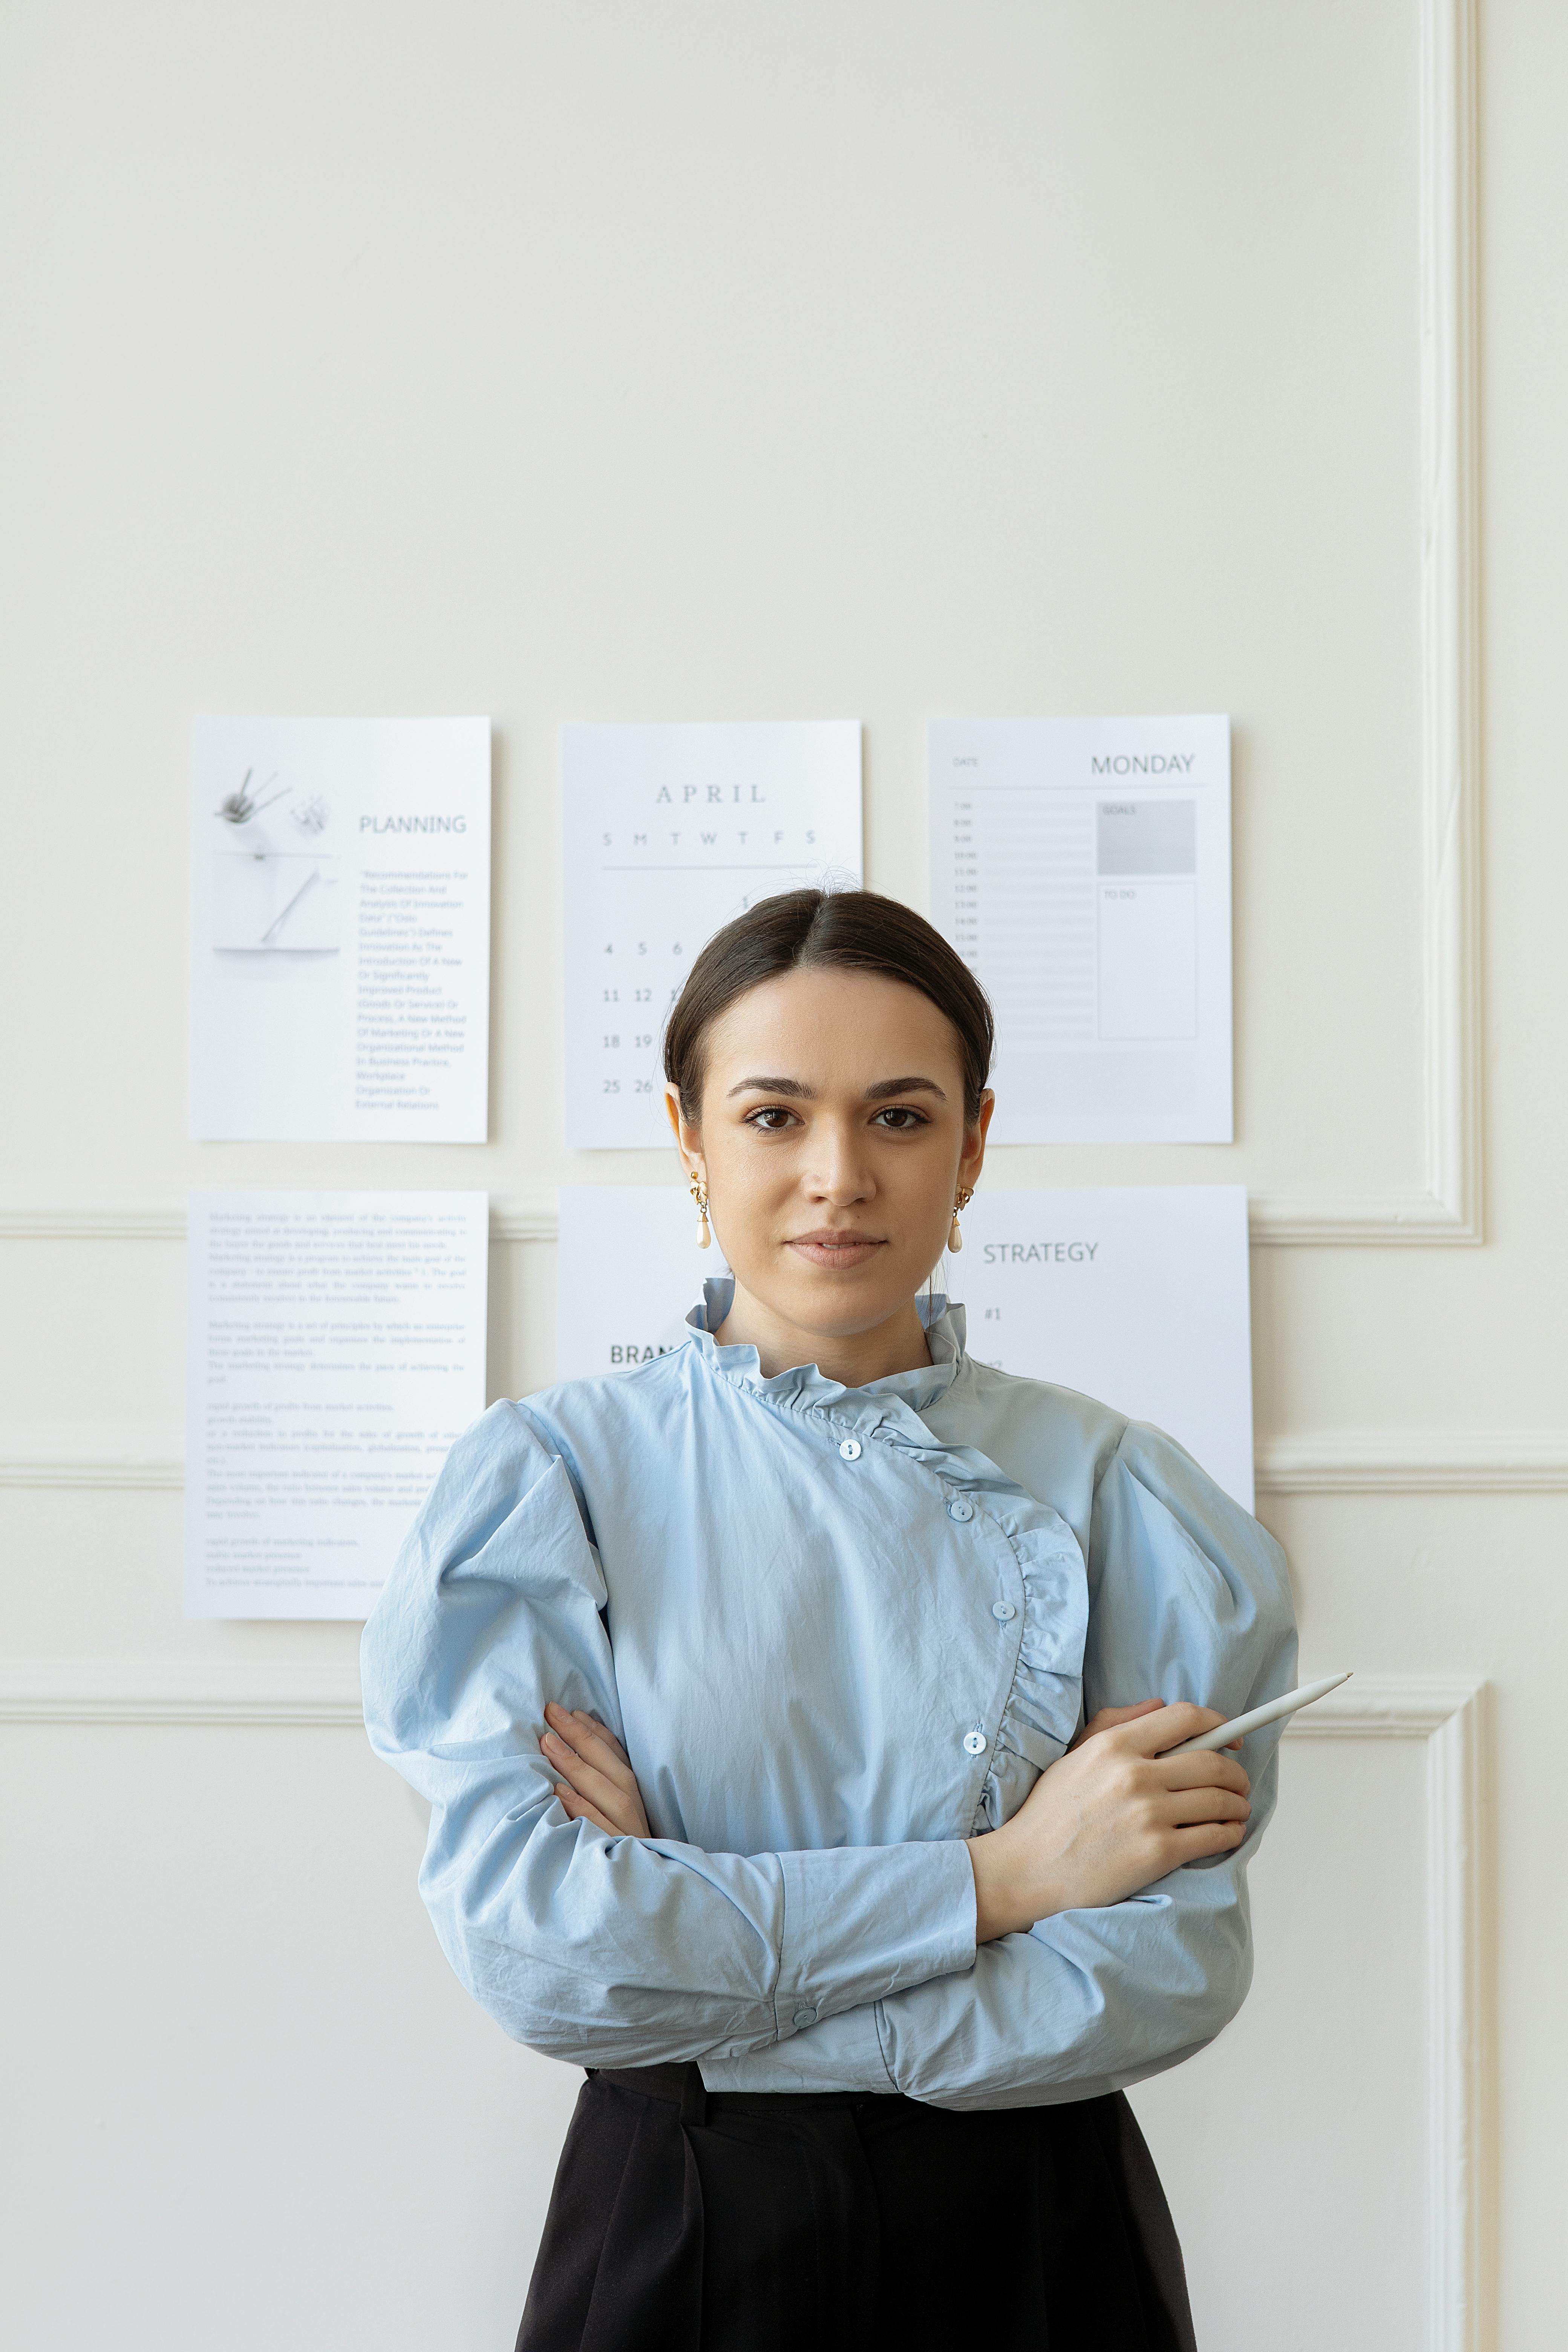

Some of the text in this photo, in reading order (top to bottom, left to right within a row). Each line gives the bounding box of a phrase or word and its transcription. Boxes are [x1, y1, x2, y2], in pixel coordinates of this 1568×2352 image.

[953, 756, 978, 767] DATE
[1092, 755, 1194, 775] MONDAY
[656, 784, 765, 803] APRIL
[1103, 805, 1135, 815] GOALS
[359, 815, 466, 833] PLANNING
[603, 830, 816, 846] S M T W T F S
[1104, 889, 1136, 899] TO DO
[604, 942, 682, 956] 4 5 6
[604, 989, 619, 1002] 11
[635, 988, 652, 1002] 12
[604, 1034, 652, 1048] 18 19
[603, 1080, 653, 1093] 25 26
[984, 1242, 1098, 1264] STRATEGY
[985, 1307, 1000, 1320] #1
